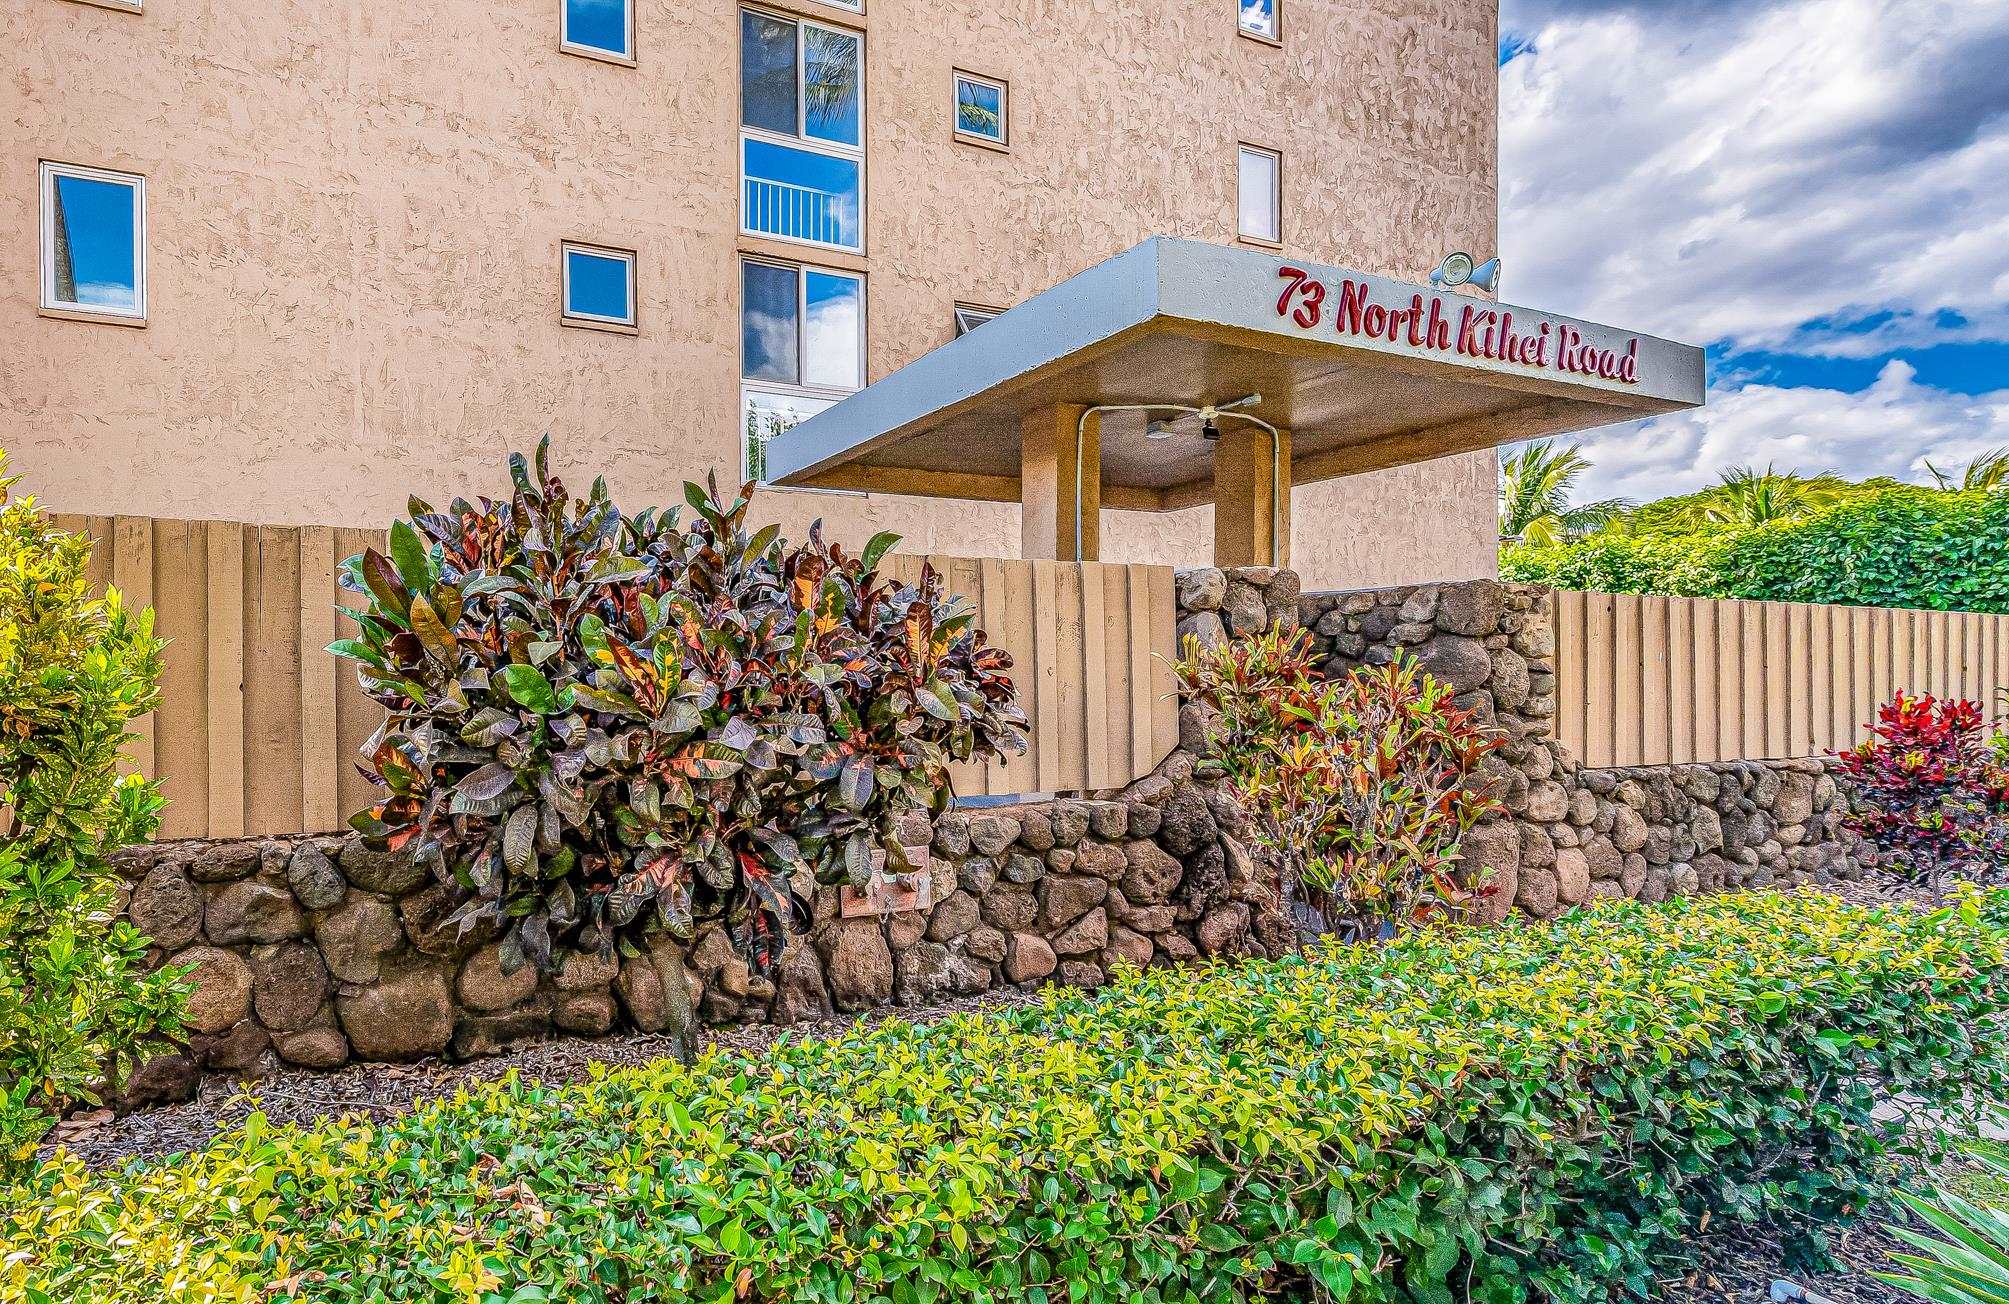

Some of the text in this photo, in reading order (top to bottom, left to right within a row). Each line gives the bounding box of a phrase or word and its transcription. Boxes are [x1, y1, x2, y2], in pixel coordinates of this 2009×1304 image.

[1276, 266, 1641, 384] 73 North Kihei Road
